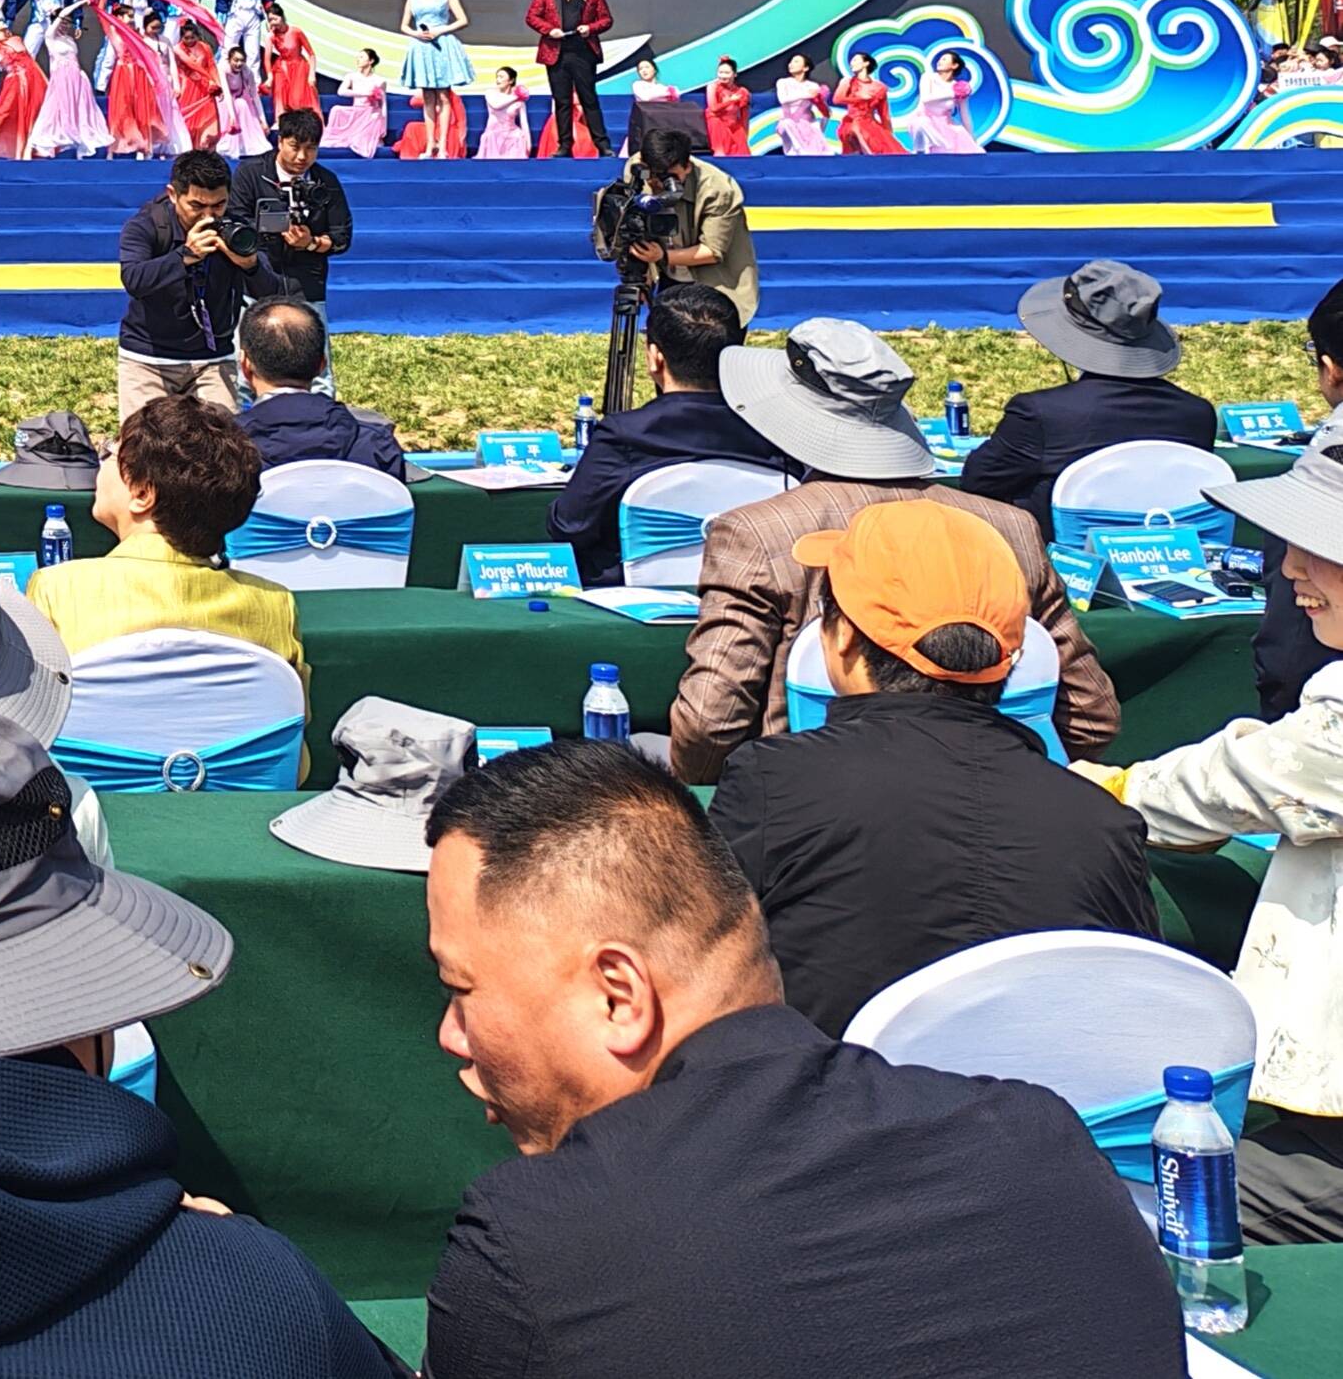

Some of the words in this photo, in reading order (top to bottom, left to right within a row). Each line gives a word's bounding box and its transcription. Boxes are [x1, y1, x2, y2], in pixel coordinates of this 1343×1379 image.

[1109, 547, 1163, 565] Hanbok
[1164, 546, 1192, 562] Lee
[479, 564, 516, 582] Jorge
[516, 562, 569, 579] Pflucker
